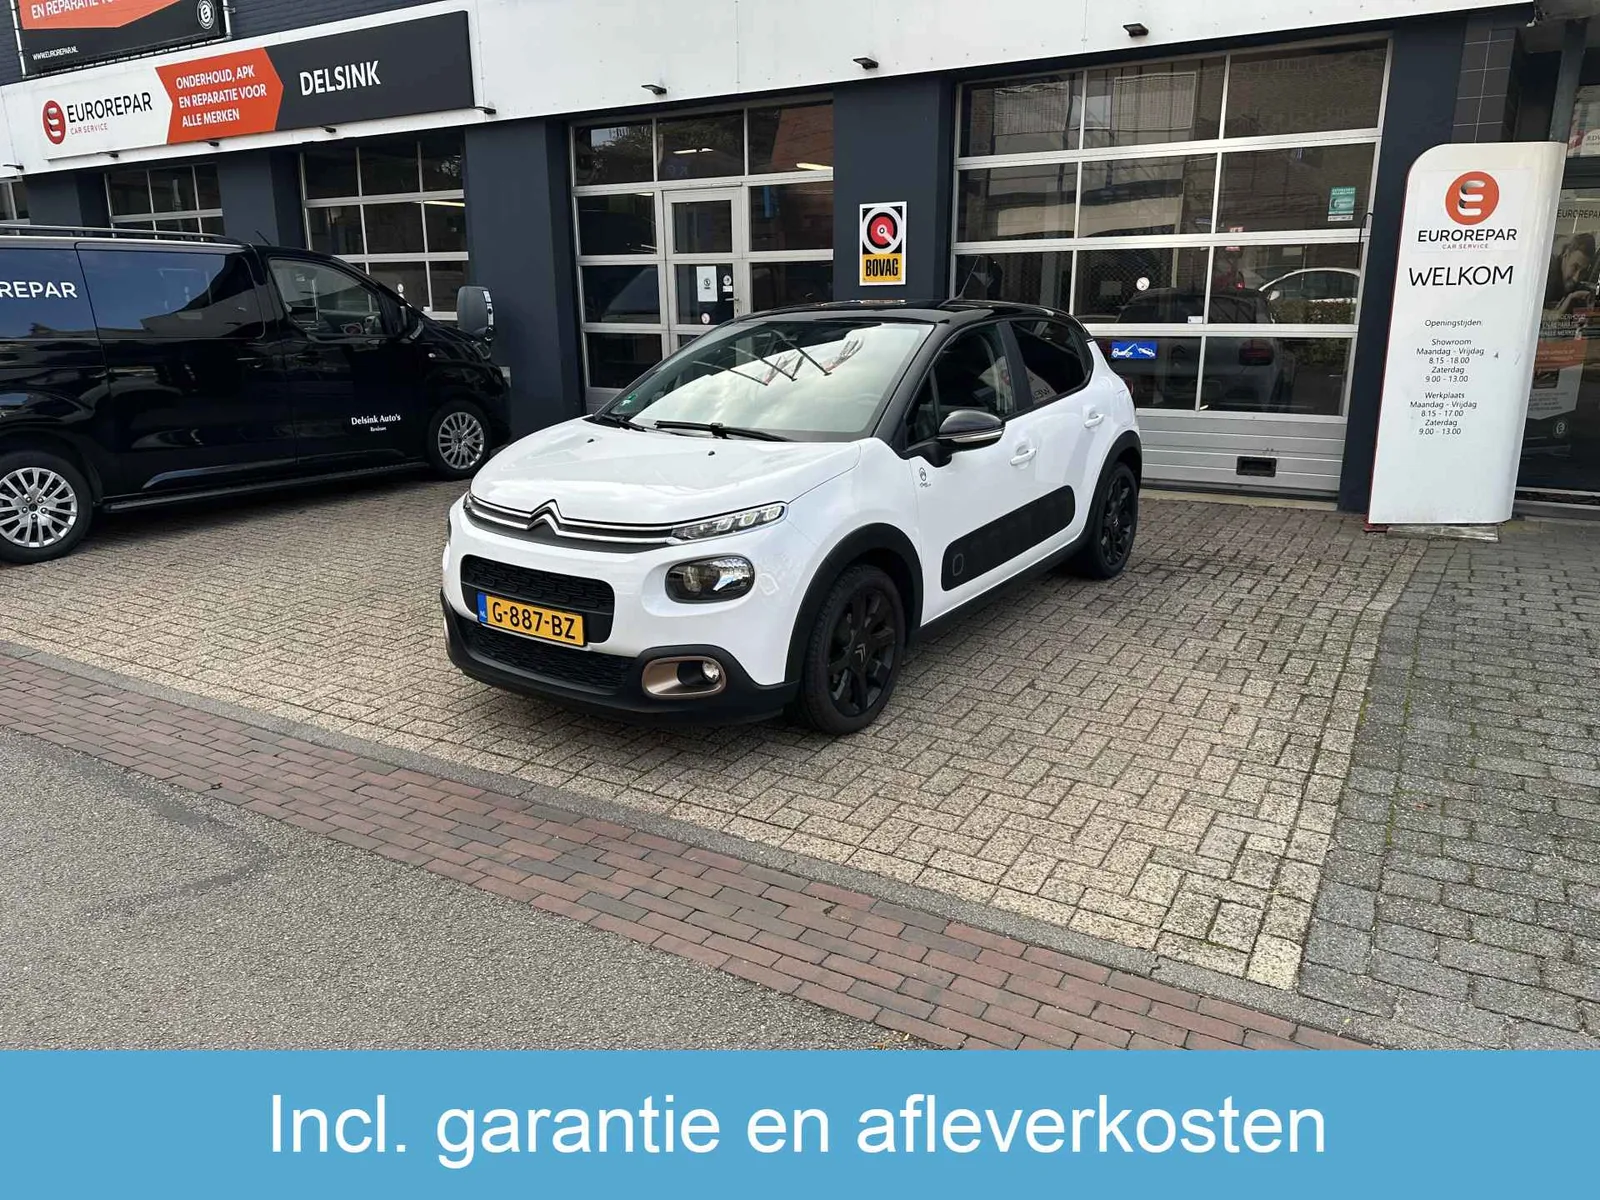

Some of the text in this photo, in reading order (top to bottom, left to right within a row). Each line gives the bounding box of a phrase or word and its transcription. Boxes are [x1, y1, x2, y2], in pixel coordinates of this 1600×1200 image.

[31, 4, 45, 19] EN
[176, 64, 255, 89] ONDERHOUD, APK
[300, 60, 381, 96] DELSINK
[179, 83, 267, 108] EN REPARATIE VOOR
[66, 92, 153, 123] EUROREPAR
[182, 108, 240, 127] ALLE MERKEN
[70, 122, 108, 135] CAR SERVICE
[1557, 209, 1600, 219] EUROREPA
[1417, 228, 1518, 243] EUROREPAR
[865, 257, 899, 277] BOVAG
[1408, 265, 1514, 287] WELKOM
[1416, 347, 1451, 356] Maandag
[1458, 346, 1485, 356] Vrijdag
[1431, 366, 1465, 374] Zaterdag
[1424, 391, 1465, 399] Werkplaats
[1409, 401, 1444, 409] Maandag
[1451, 400, 1478, 409] Vrijdag
[351, 414, 402, 425] Delsink Auto's
[1424, 419, 1458, 427] Zaterdag
[1441, 427, 1462, 435] 13.00
[492, 601, 576, 640] G-887-BZ
